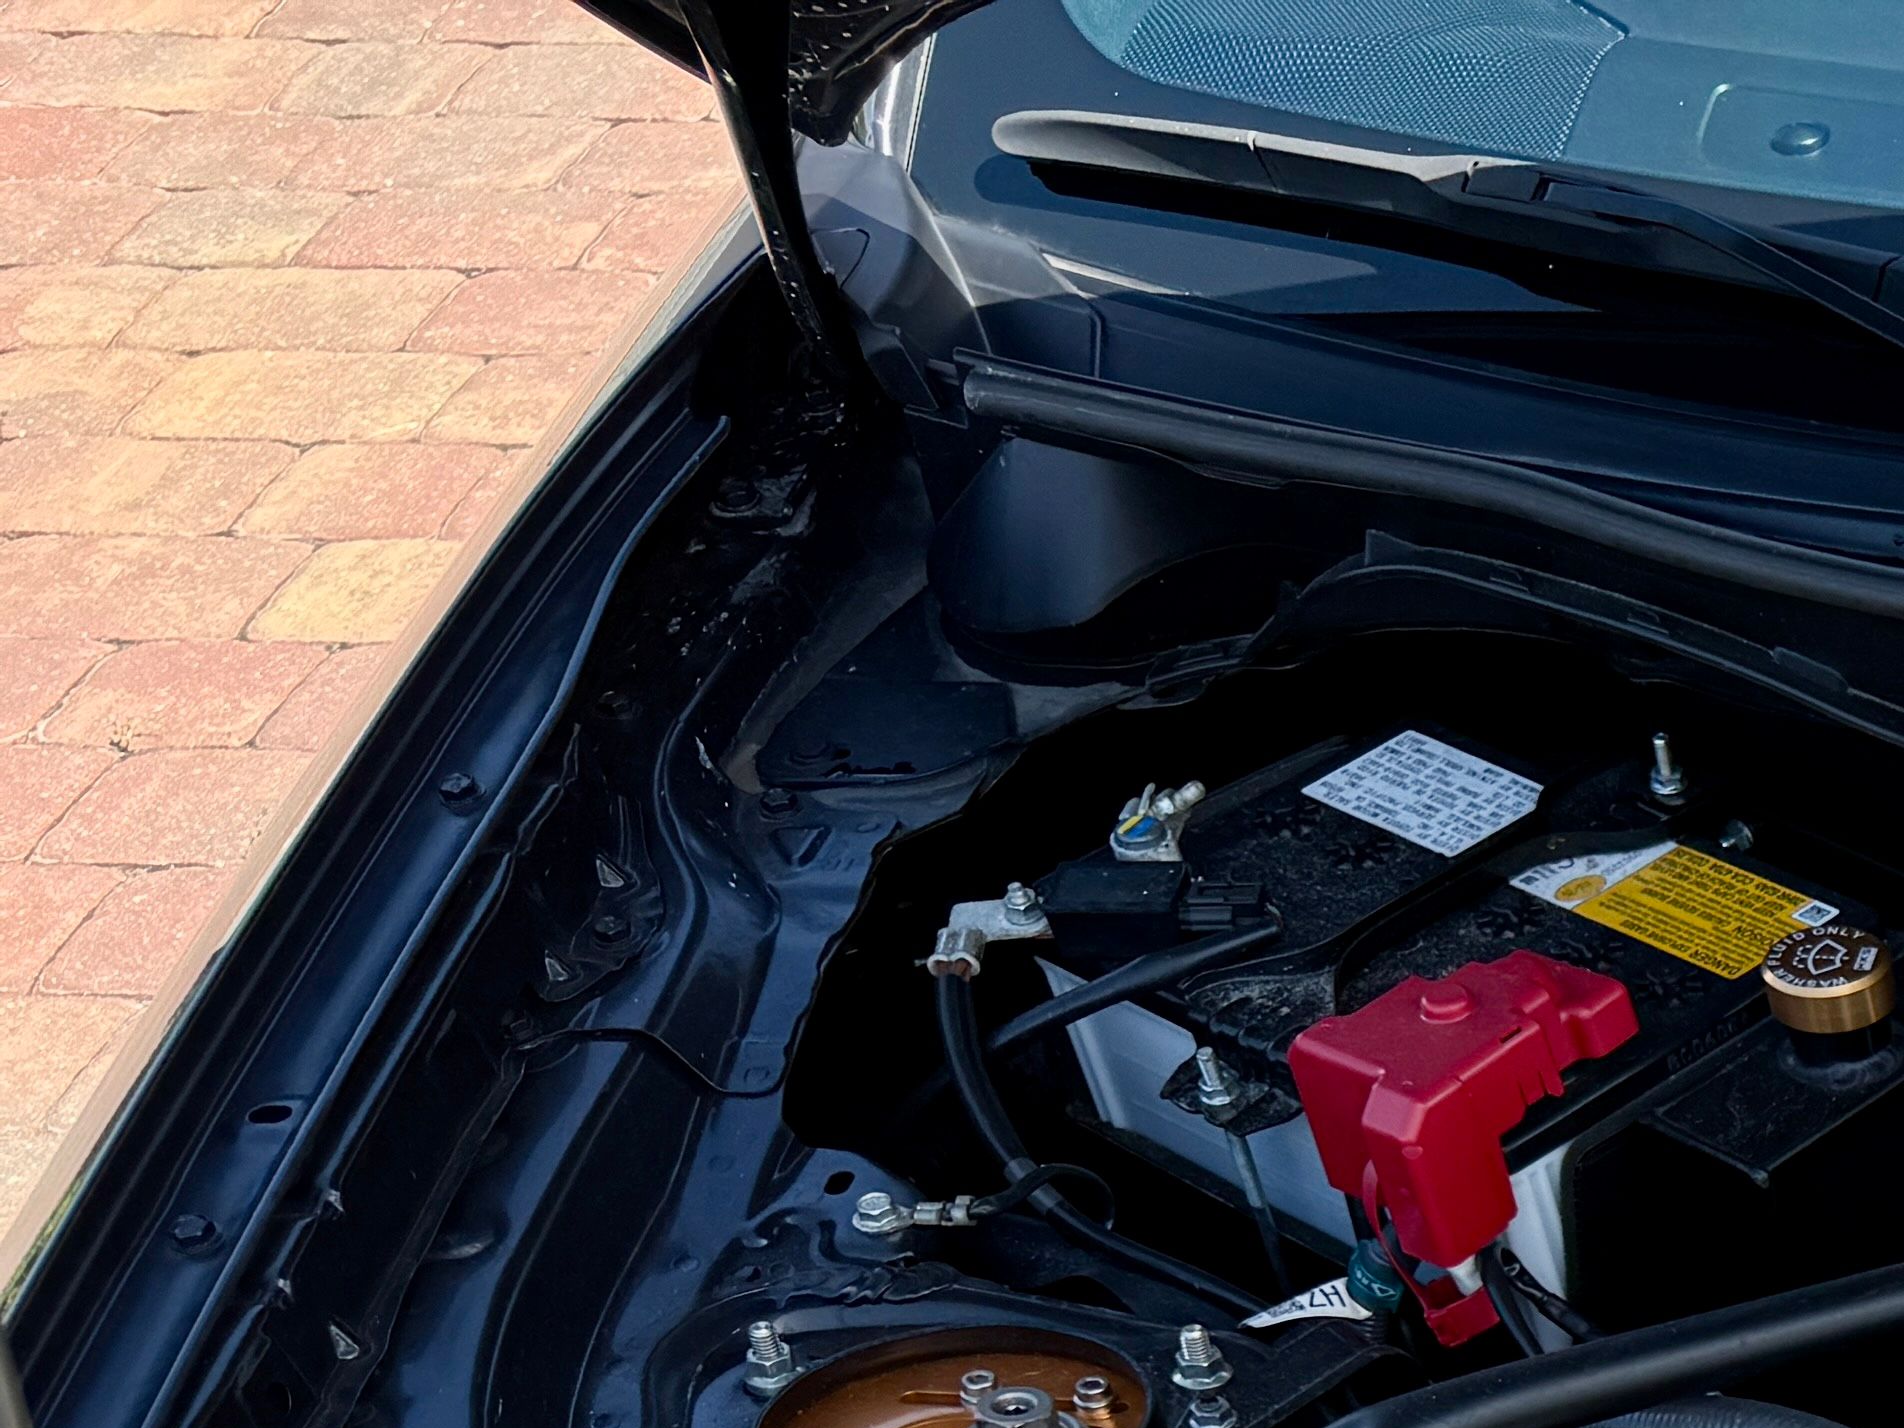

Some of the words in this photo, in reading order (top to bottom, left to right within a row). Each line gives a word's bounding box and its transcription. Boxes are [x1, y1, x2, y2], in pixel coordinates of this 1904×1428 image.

[1812, 926, 1864, 939] ONLY
[1766, 931, 1805, 966] FLUID
[1681, 949, 1748, 974] DANGER
[1773, 968, 1847, 987] WASHER
[1308, 1285, 1346, 1308] H7
